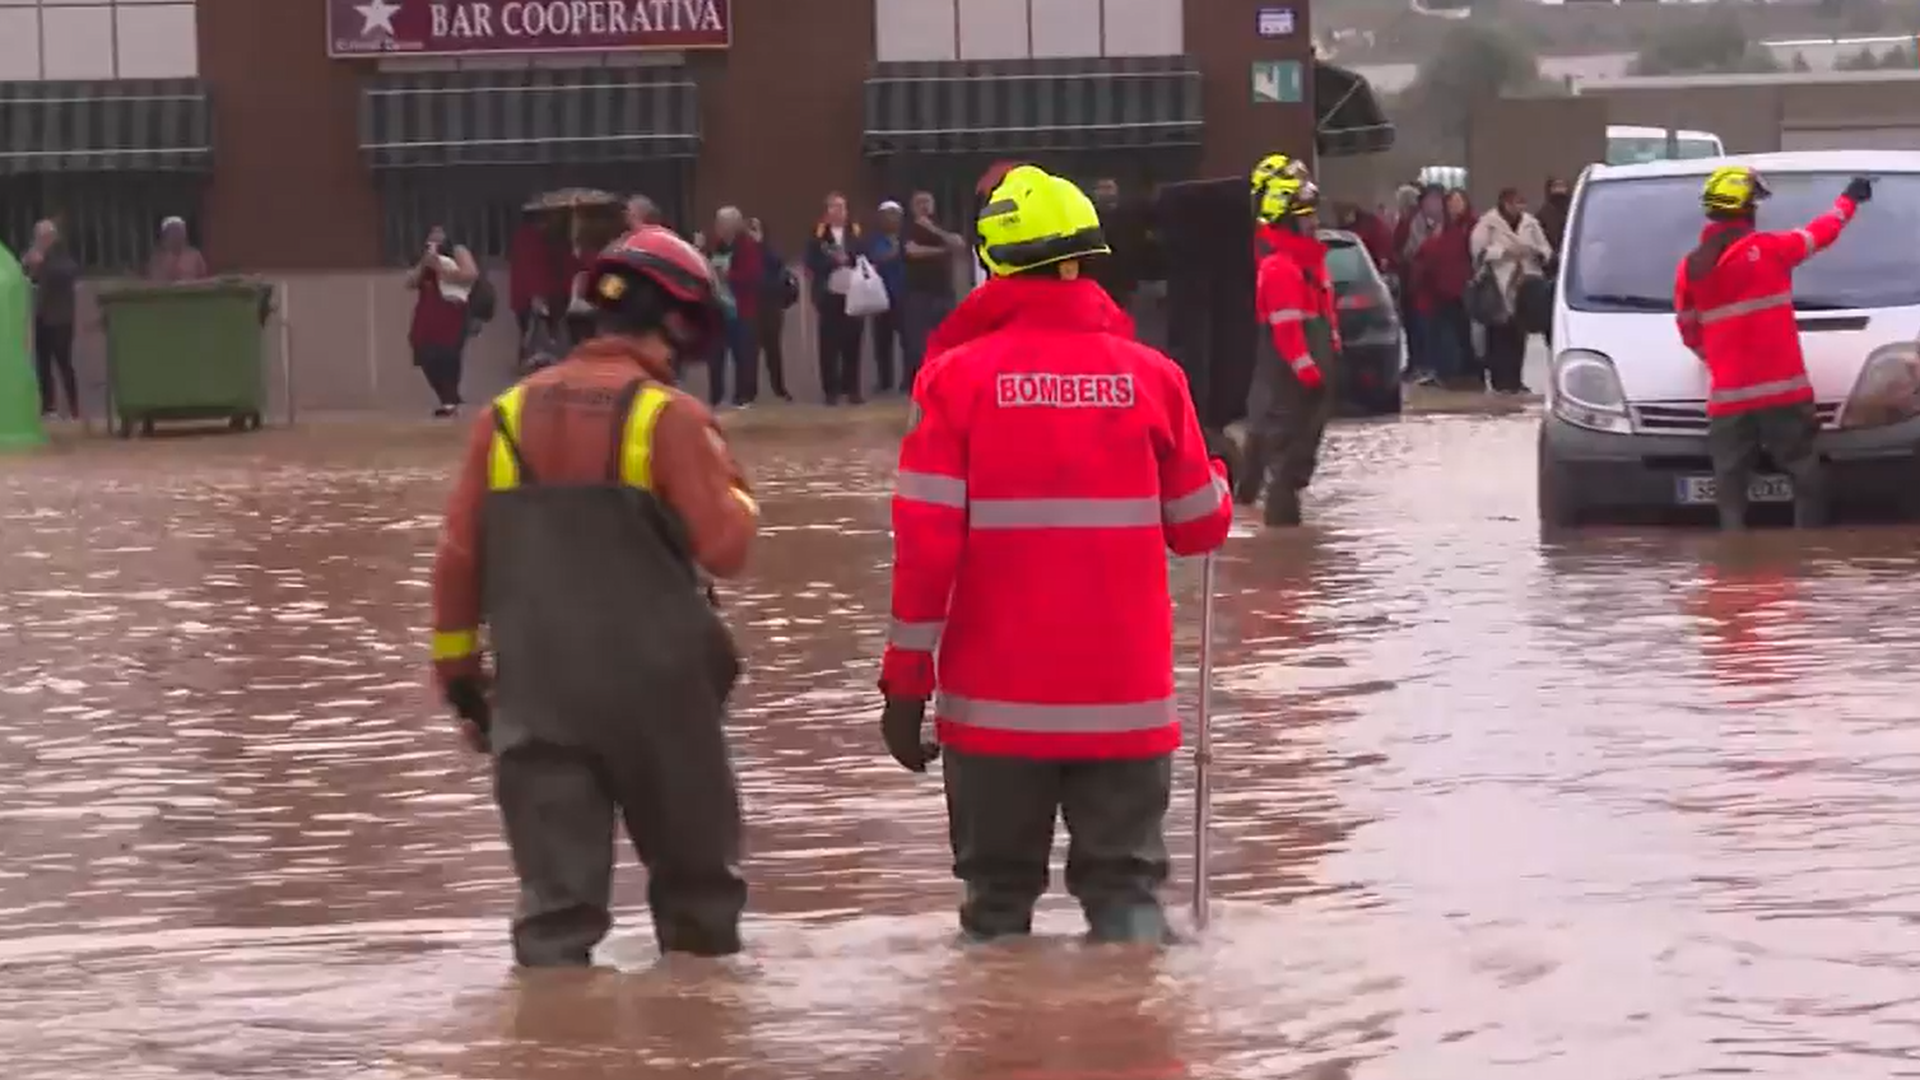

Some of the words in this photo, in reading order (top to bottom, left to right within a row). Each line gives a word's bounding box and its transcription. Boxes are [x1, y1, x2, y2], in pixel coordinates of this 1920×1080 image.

[430, 3, 494, 36] BAR
[501, 0, 723, 35] COOPERATIVA
[998, 375, 1133, 405] BOMBERS
